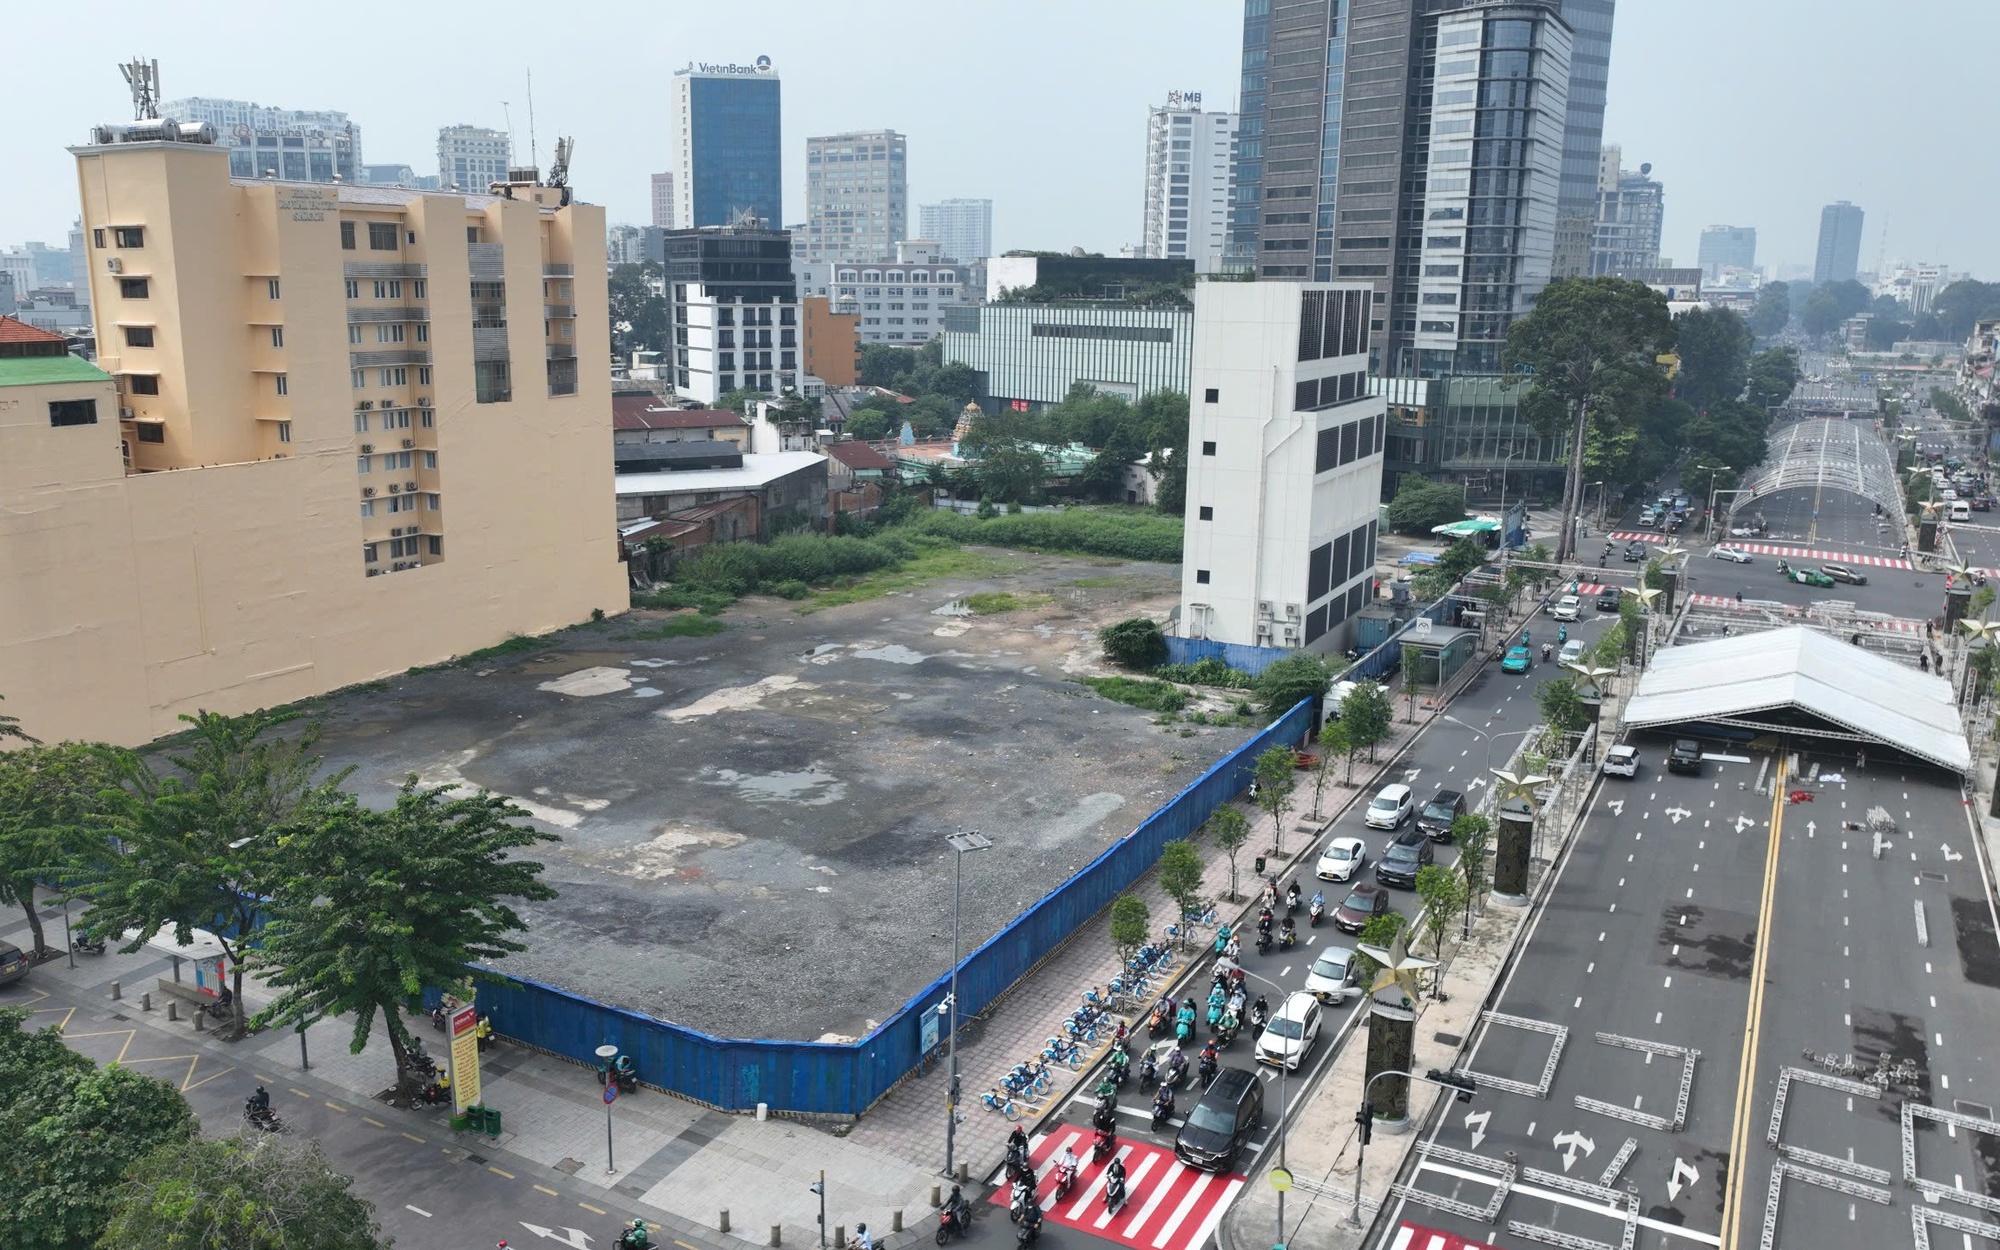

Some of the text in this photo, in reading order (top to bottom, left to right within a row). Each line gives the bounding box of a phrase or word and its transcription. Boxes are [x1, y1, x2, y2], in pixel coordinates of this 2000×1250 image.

[699, 62, 757, 75] VietinBank
[1183, 92, 1201, 102] MB
[255, 128, 324, 138] Hanwha Life
[1373, 998, 1414, 1012] Vietcombank
